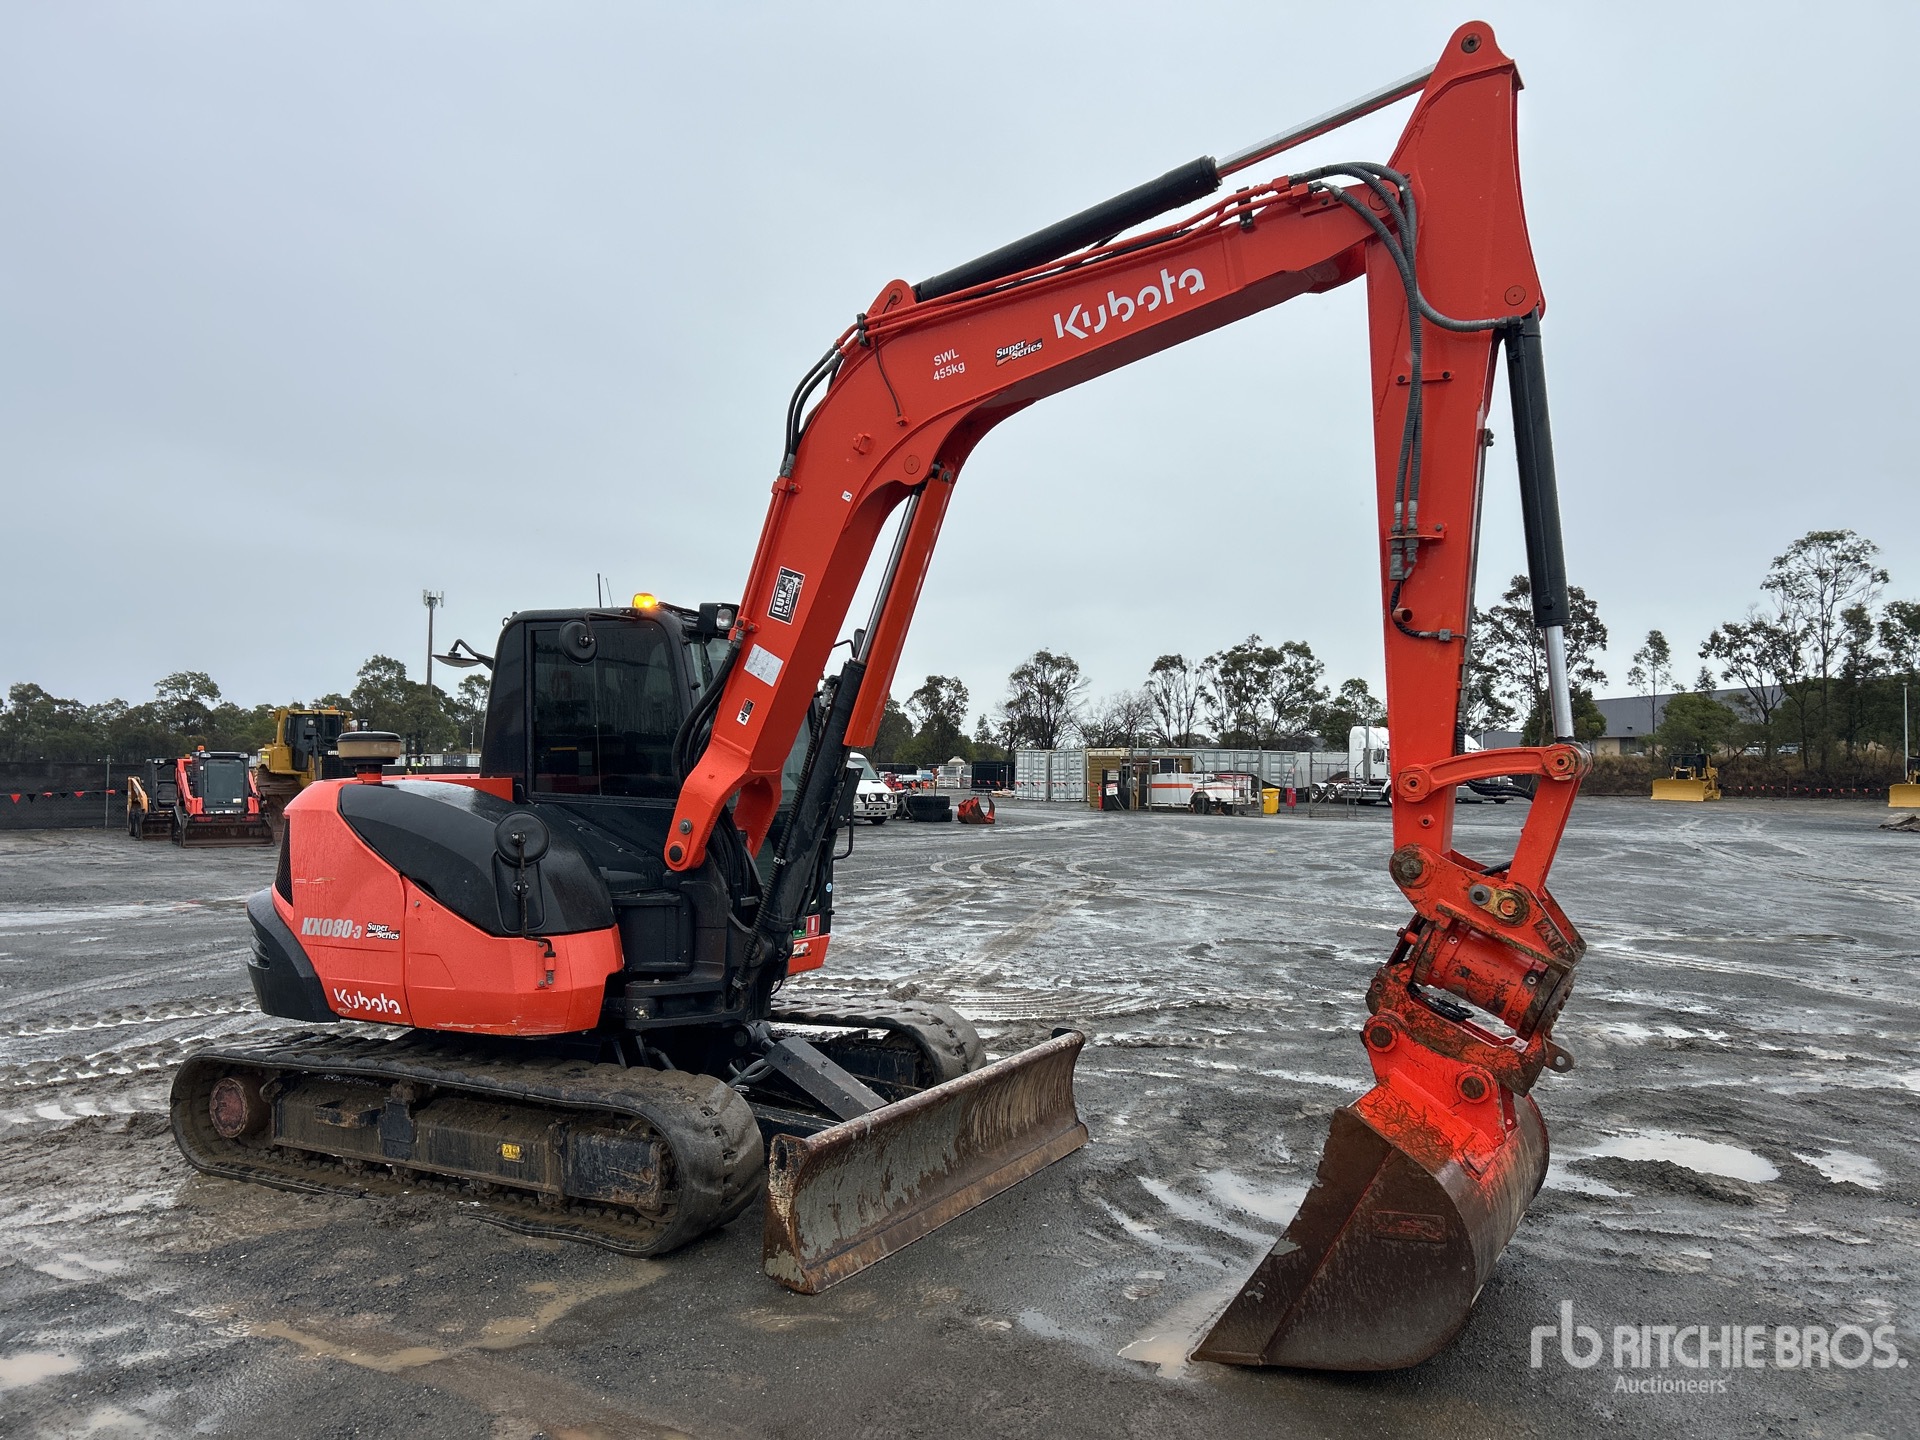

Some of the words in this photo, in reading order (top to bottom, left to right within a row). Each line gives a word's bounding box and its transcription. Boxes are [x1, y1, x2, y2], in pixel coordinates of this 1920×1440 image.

[1054, 267, 1206, 339] Kubota
[934, 349, 960, 366] SWL
[996, 340, 1026, 358] Super
[1011, 341, 1042, 360] Series
[933, 361, 965, 381] 455kg
[301, 917, 362, 939] KX080-3
[367, 922, 389, 932] Super
[377, 931, 399, 940] Series
[333, 988, 402, 1014] Kubota
